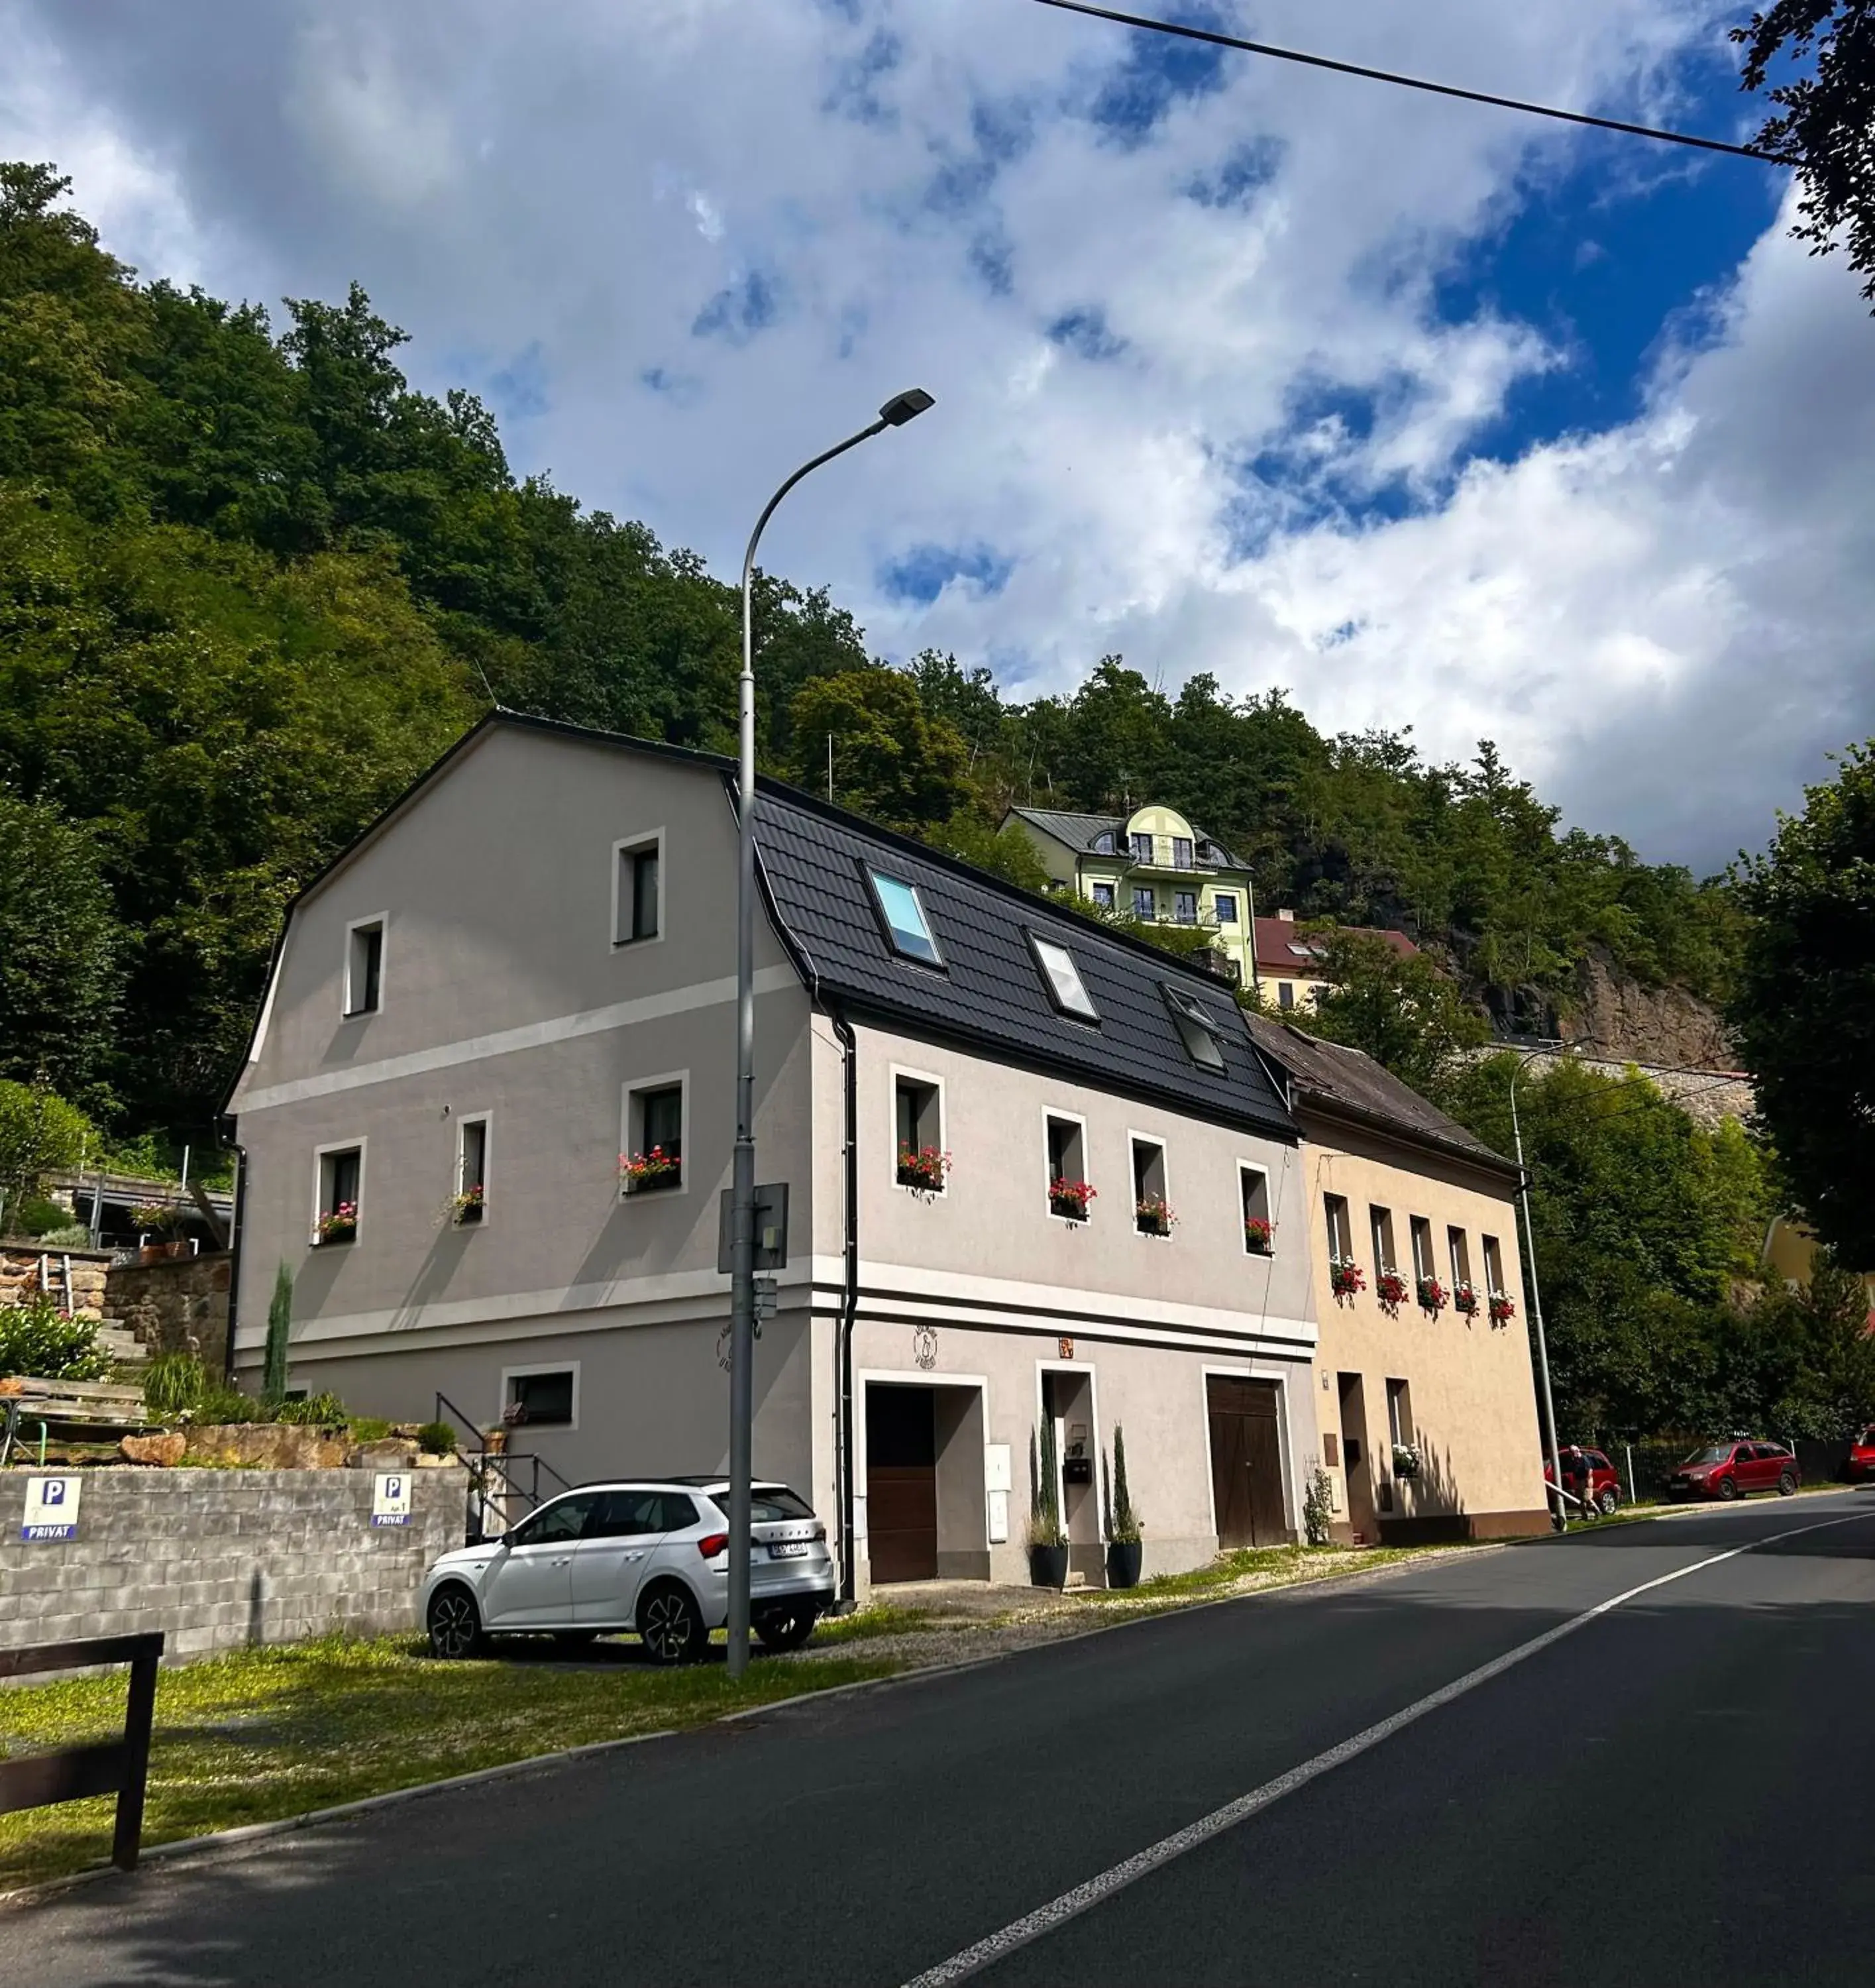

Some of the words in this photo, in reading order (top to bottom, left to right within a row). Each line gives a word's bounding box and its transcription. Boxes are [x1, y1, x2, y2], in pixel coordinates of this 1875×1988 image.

[46, 1481, 63, 1504] P
[388, 1478, 399, 1497] P
[376, 1515, 405, 1525] PRIVAT
[28, 1525, 70, 1538] PRIVAT
